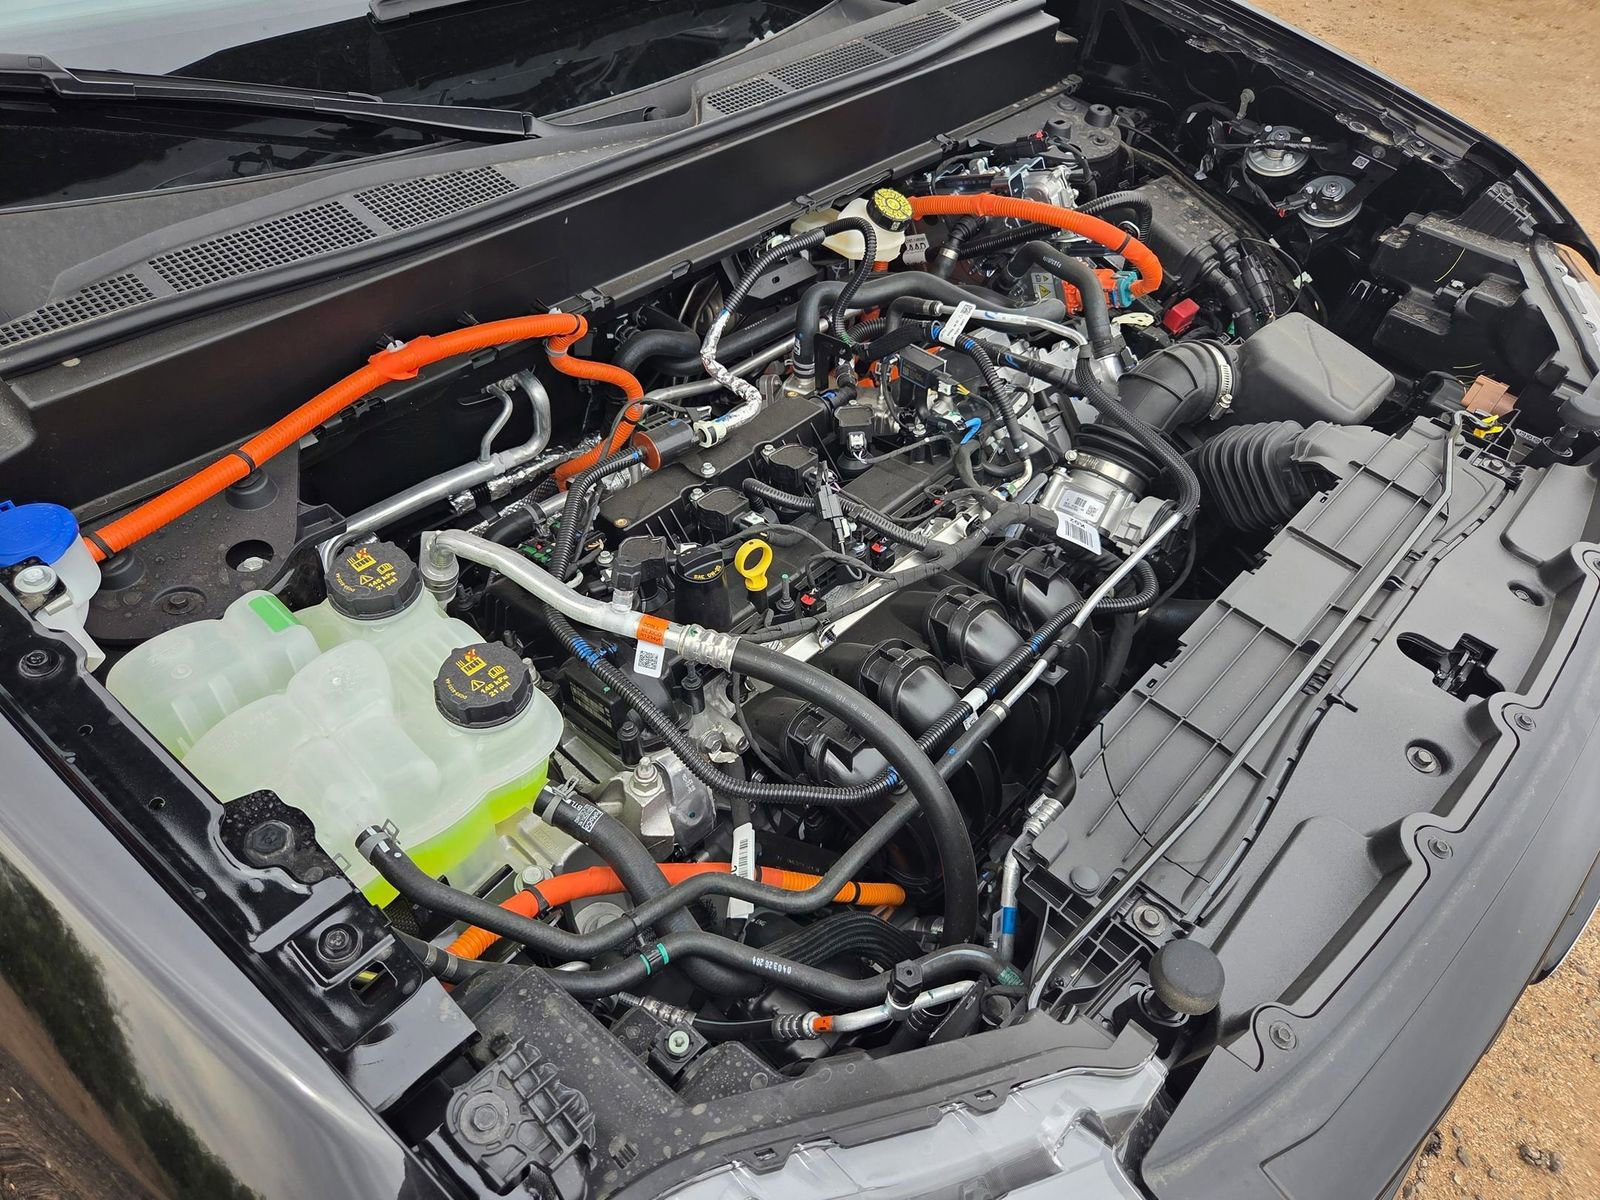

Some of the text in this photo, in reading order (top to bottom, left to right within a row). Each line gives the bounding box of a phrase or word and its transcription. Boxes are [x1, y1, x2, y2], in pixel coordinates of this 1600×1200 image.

[368, 571, 397, 588] 145 kPa
[375, 576, 399, 592] 21 psi
[480, 683, 495, 694] 145
[493, 675, 509, 686] kPa
[488, 681, 512, 698] 21 psi
